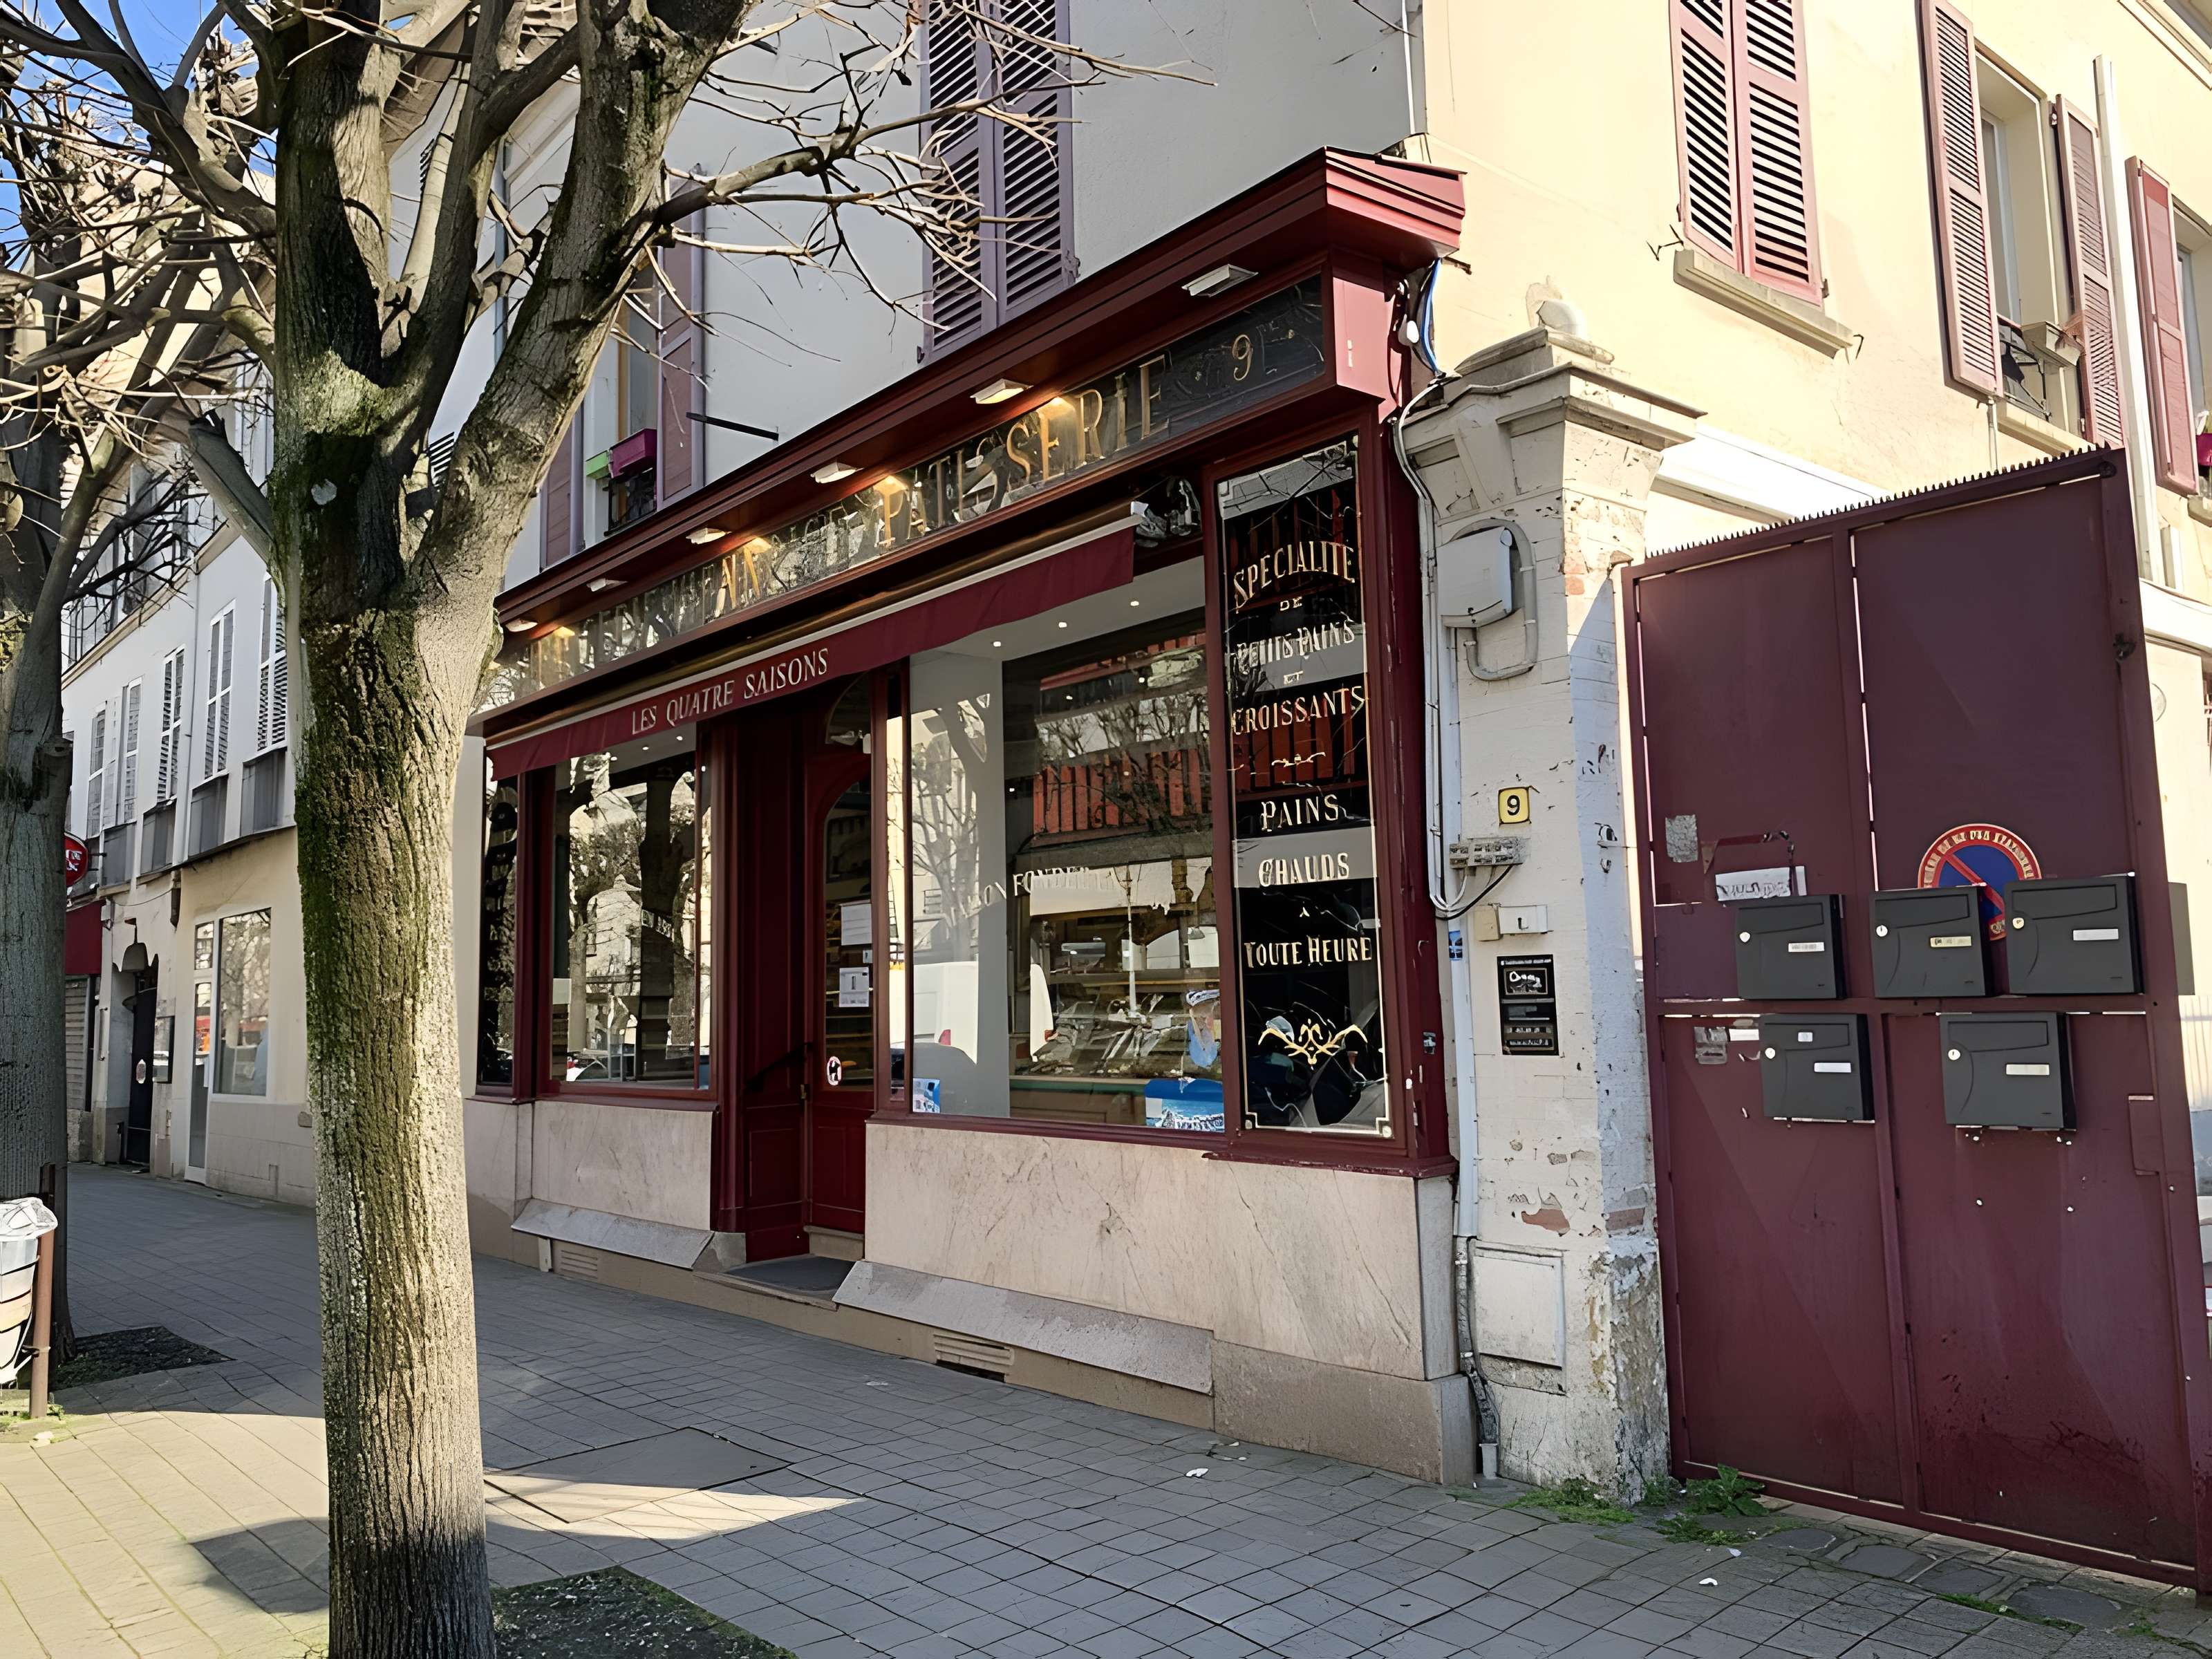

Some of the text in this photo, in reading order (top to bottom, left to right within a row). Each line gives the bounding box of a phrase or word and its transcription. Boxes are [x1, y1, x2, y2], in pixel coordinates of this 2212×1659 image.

[1232, 334, 1253, 381] 9
[1280, 596, 1302, 611] DE
[632, 647, 828, 735] LES QUATRE SAISONS
[1283, 671, 1304, 685] ET
[1232, 686, 1365, 735] CROISSANTS
[1260, 794, 1339, 832] PAINS
[1507, 794, 1520, 816] 9
[1259, 852, 1349, 887] CHAUDS
[1244, 935, 1372, 968] TOUTE HEURE
